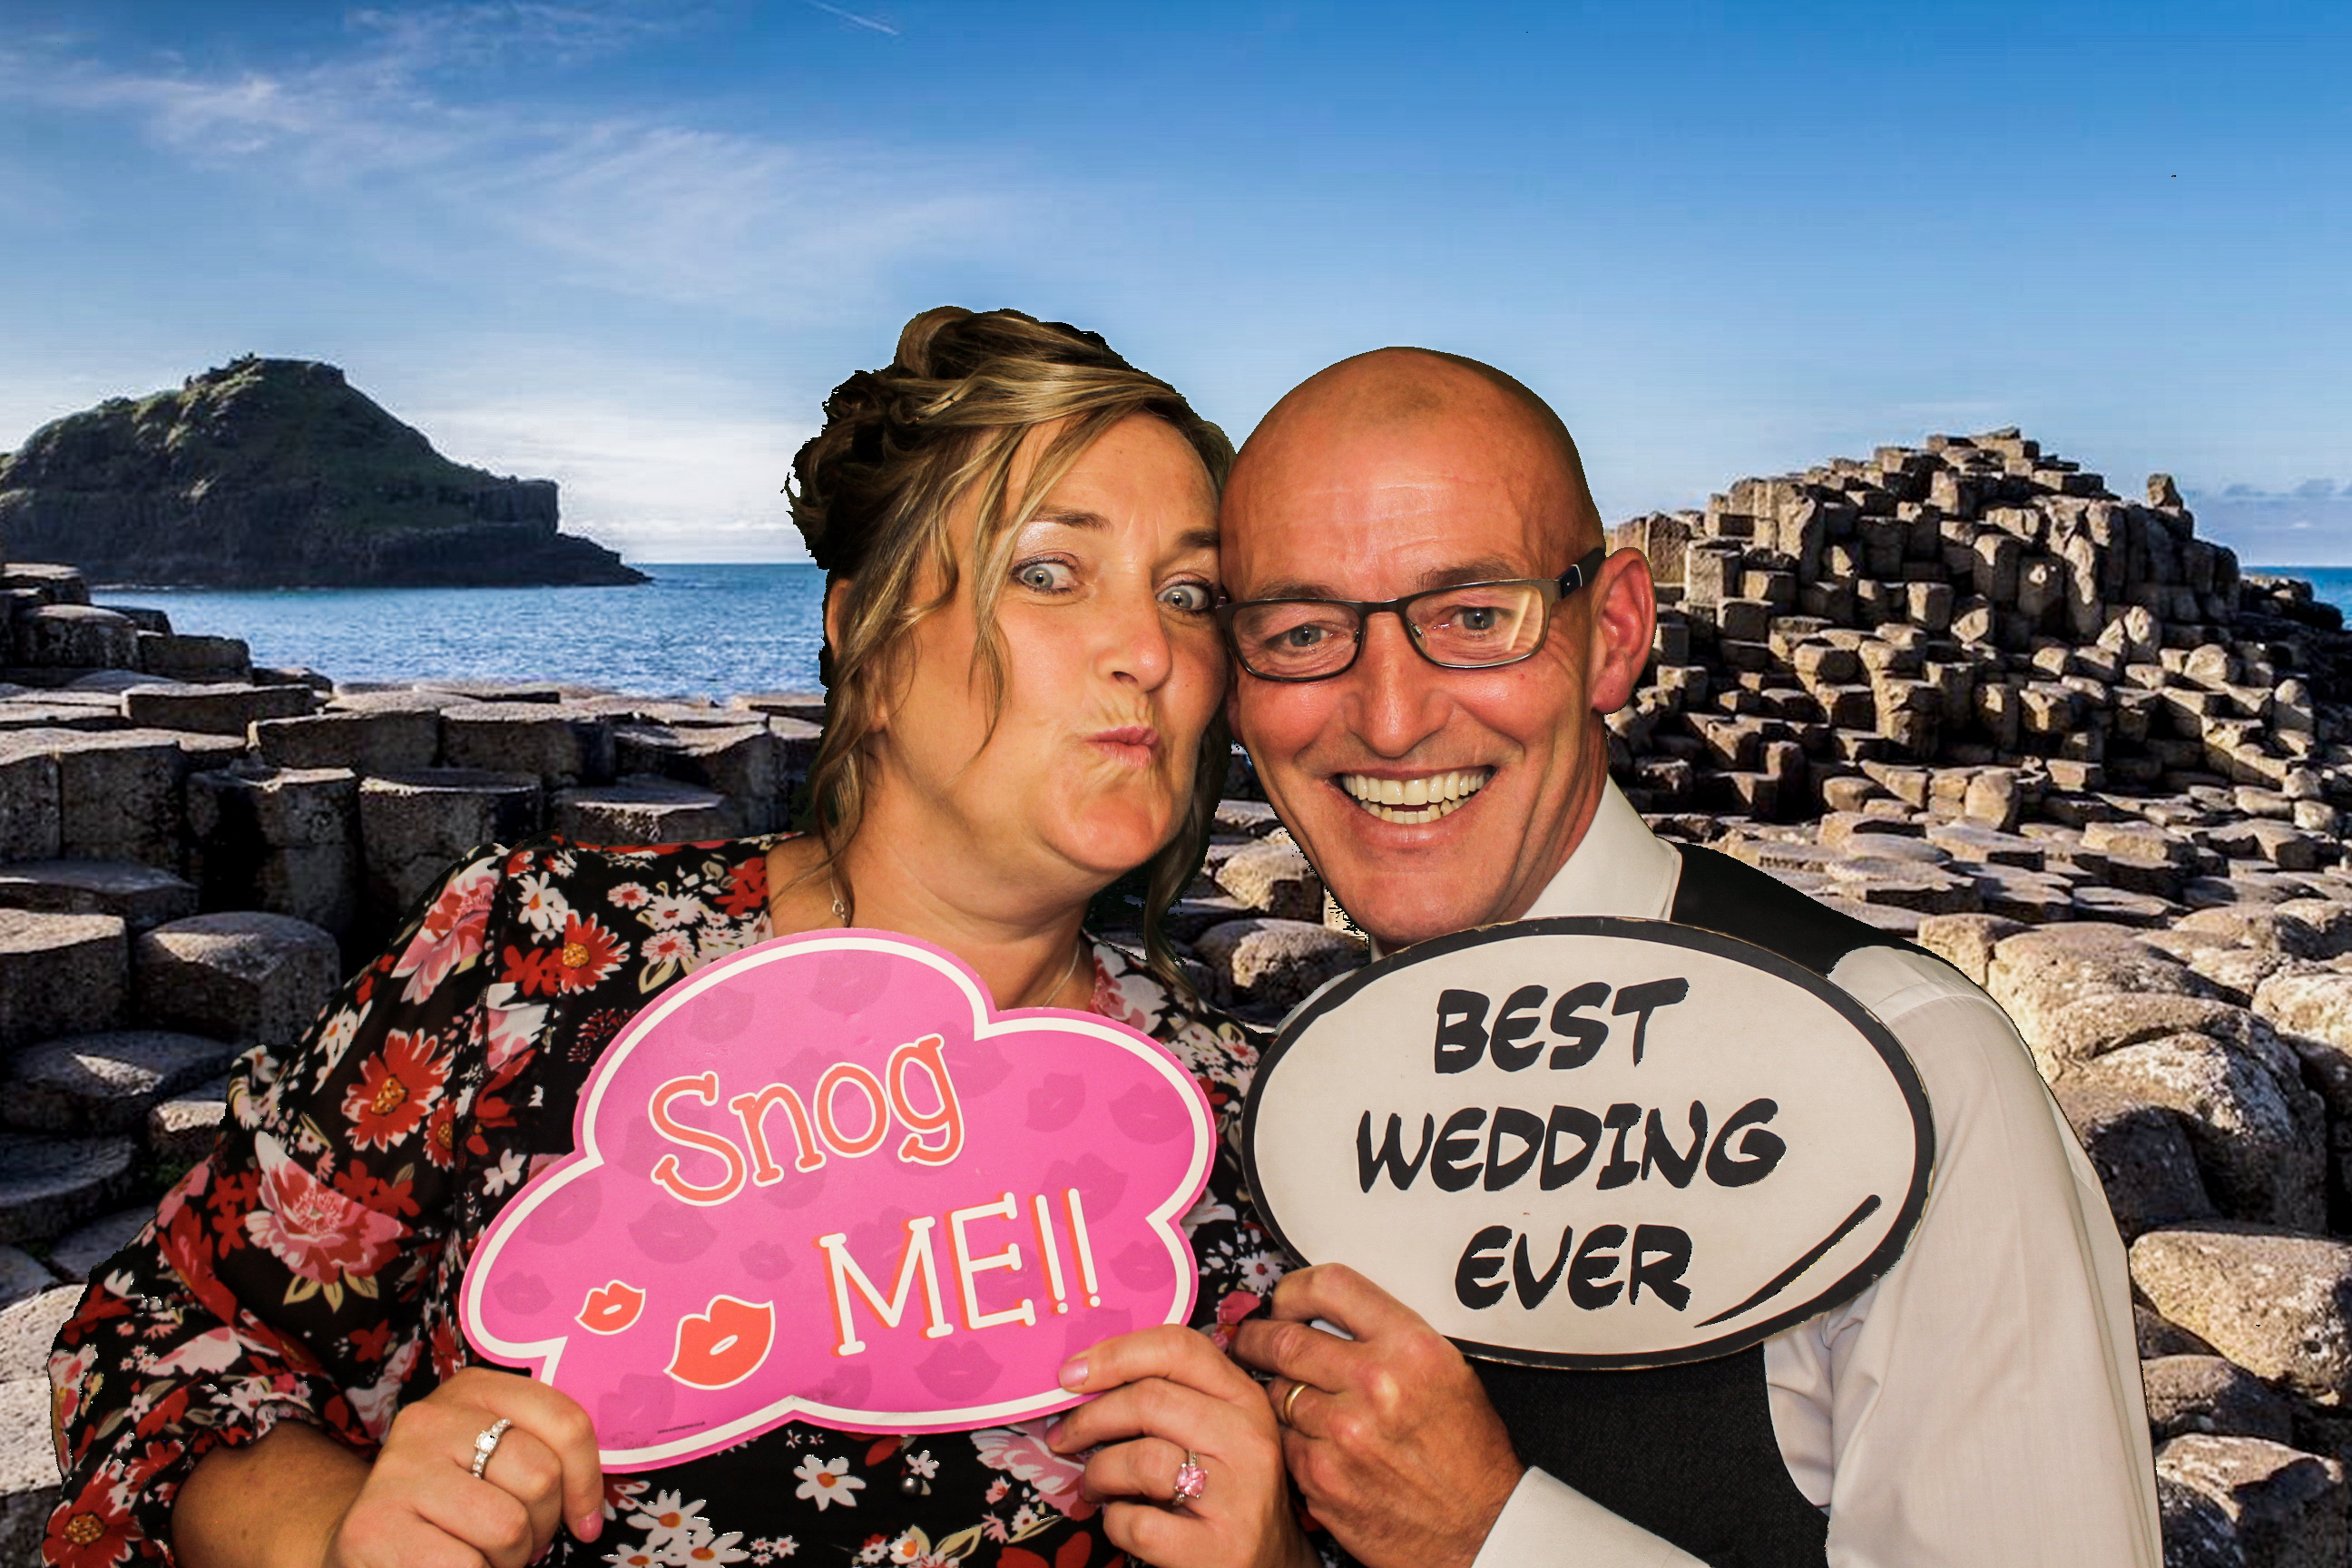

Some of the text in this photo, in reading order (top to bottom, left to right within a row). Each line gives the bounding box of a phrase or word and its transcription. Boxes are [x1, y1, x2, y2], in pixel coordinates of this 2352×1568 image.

[1435, 977, 1690, 1074] BEST
[648, 1033, 965, 1207] Snog
[1357, 1098, 1787, 1192] WEDDING
[813, 1187, 1102, 1357] ME!!
[1455, 1223, 1693, 1311] EVER
